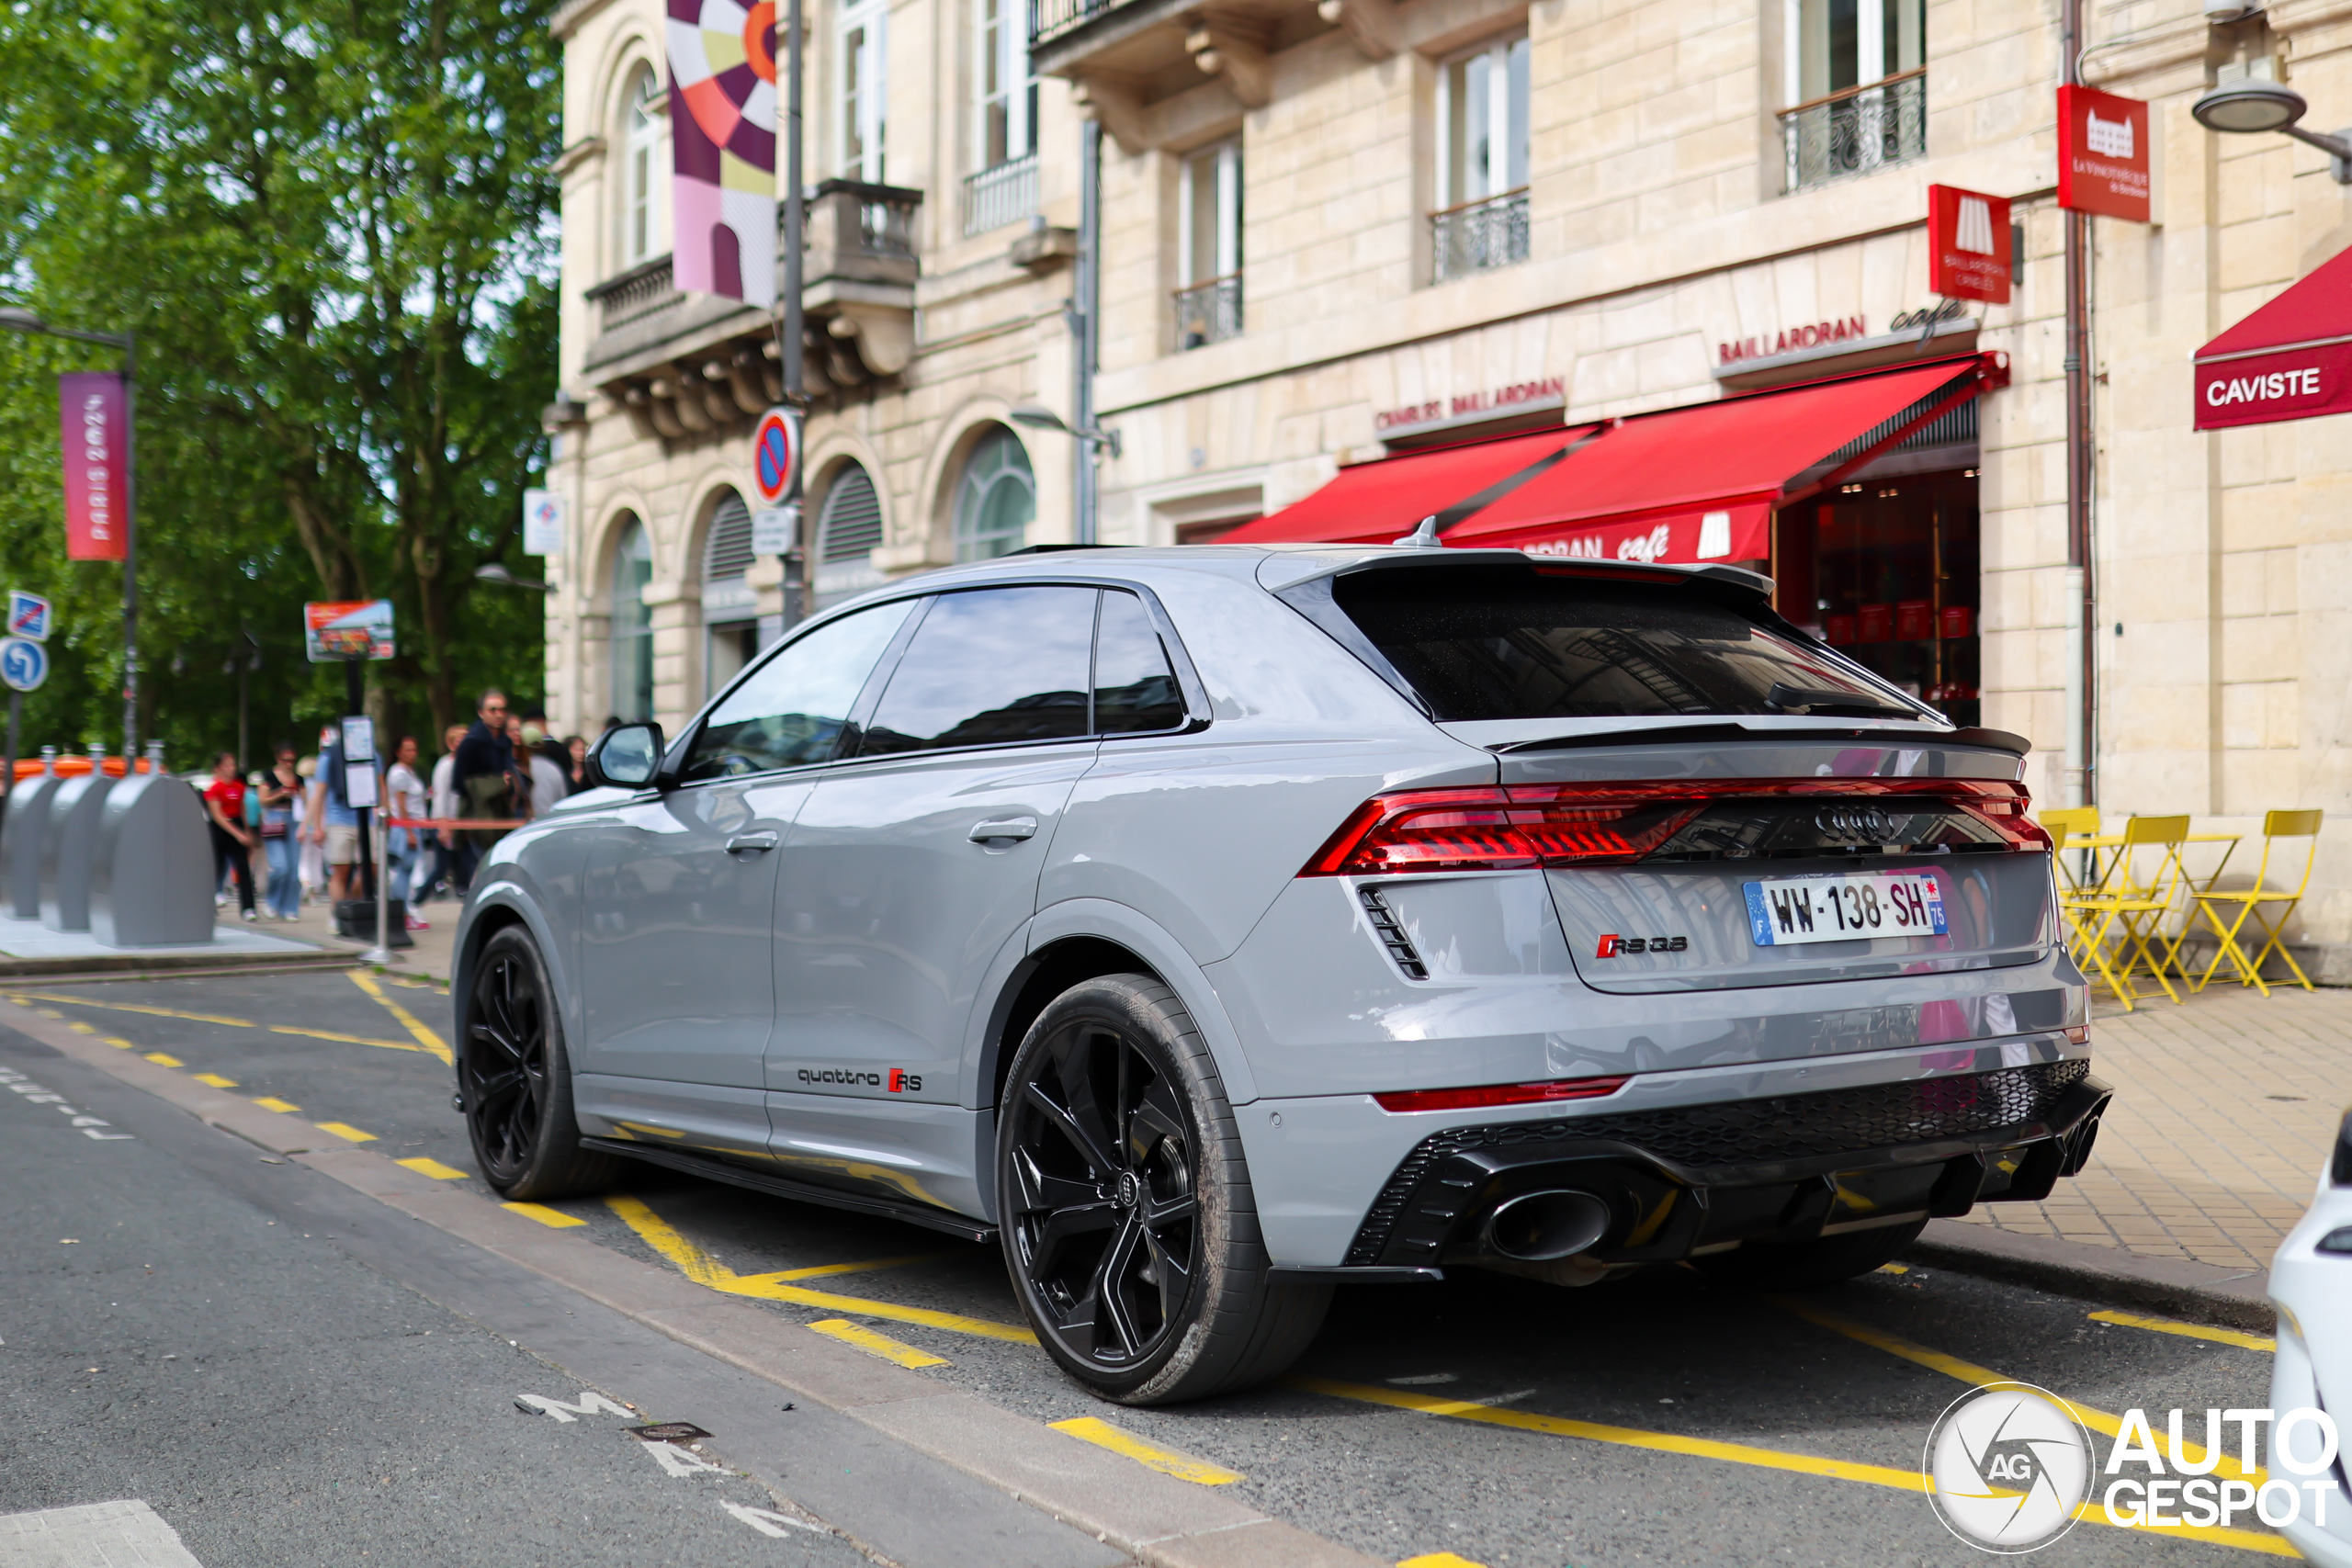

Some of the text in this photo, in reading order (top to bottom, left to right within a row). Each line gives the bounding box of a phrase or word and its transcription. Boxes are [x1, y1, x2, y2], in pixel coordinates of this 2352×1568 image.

[2207, 367, 2321, 406] CAVISTE
[84, 394, 110, 541] PARIS 2024
[1770, 882, 1928, 934] WW-138-SH
[1930, 907, 1945, 926] 75
[1756, 919, 1764, 933] F
[1607, 936, 1688, 954] RS Q8
[797, 1068, 922, 1091] quattro RS
